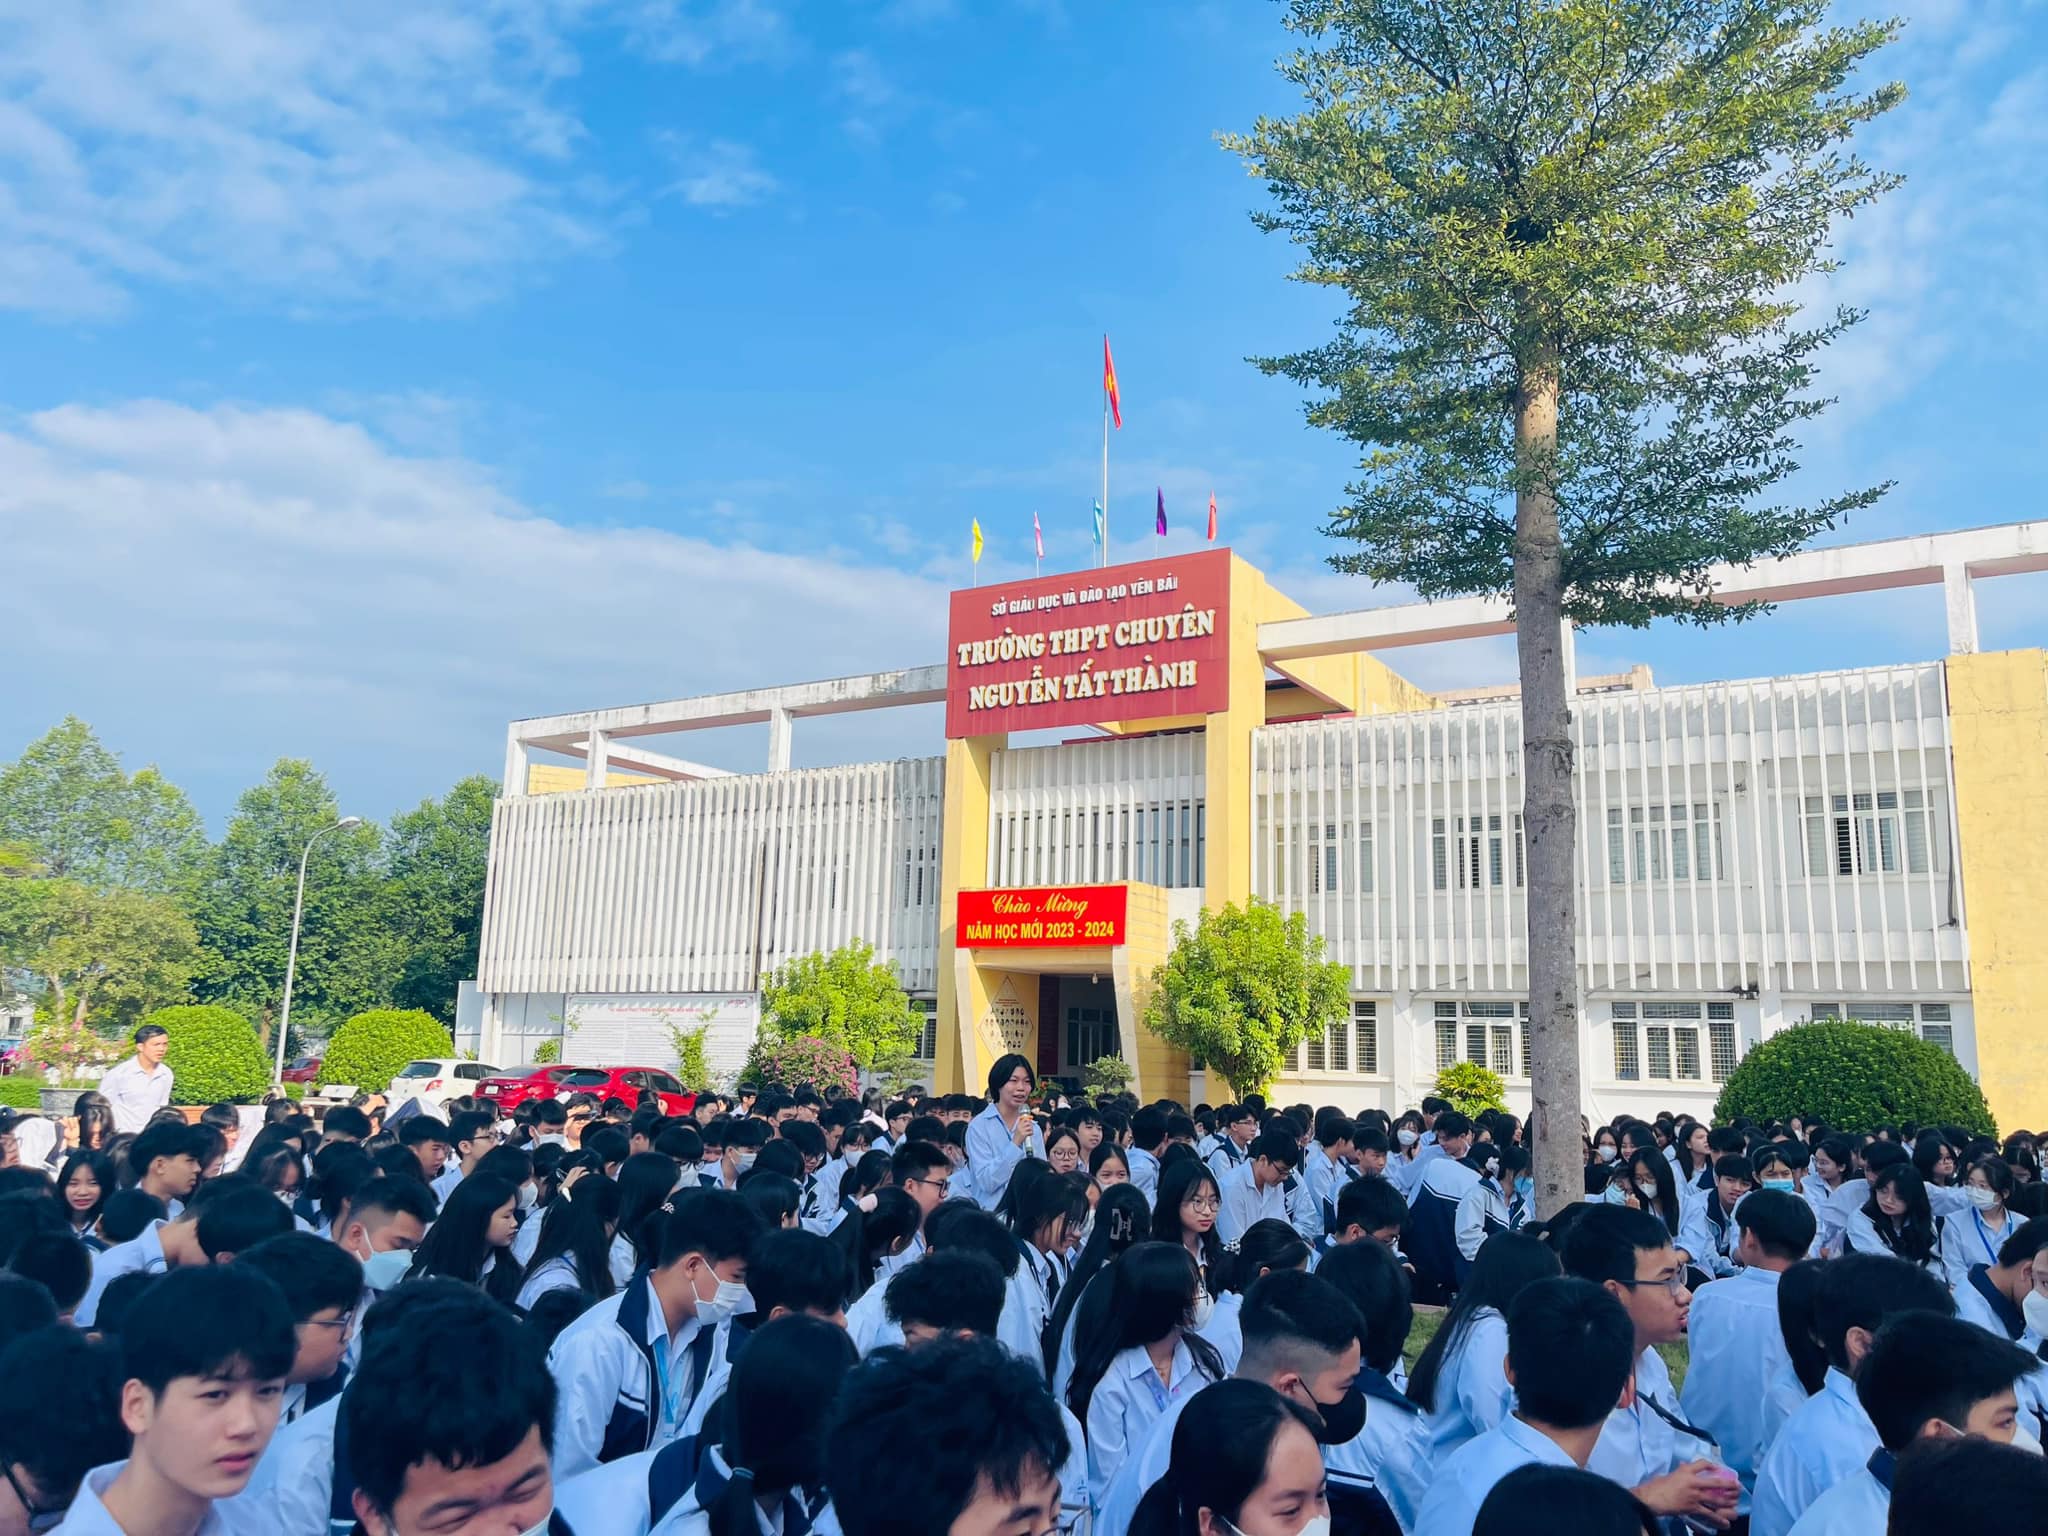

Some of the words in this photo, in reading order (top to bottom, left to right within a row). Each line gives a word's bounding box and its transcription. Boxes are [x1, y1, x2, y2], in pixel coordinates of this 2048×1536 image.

[1038, 594, 1060, 613] DỤC
[1062, 587, 1076, 606] VÀ
[1080, 584, 1103, 603] ĐÀO
[1130, 577, 1153, 596] YÊN
[957, 627, 1046, 667] TRƯỜNG
[1049, 623, 1110, 656] THPT
[1114, 603, 1216, 648] CHUYÊN
[968, 665, 1061, 711] NGUYỄN
[1064, 658, 1110, 700] TẤT
[1110, 654, 1198, 696] THÀNH
[992, 893, 1032, 914] Chào
[1035, 892, 1089, 919] Mừng
[966, 920, 992, 941] NĂM
[994, 924, 1018, 944] HỌC
[1020, 918, 1043, 940] MỚI
[1045, 922, 1075, 939] 2023
[1084, 921, 1115, 938] 2024
